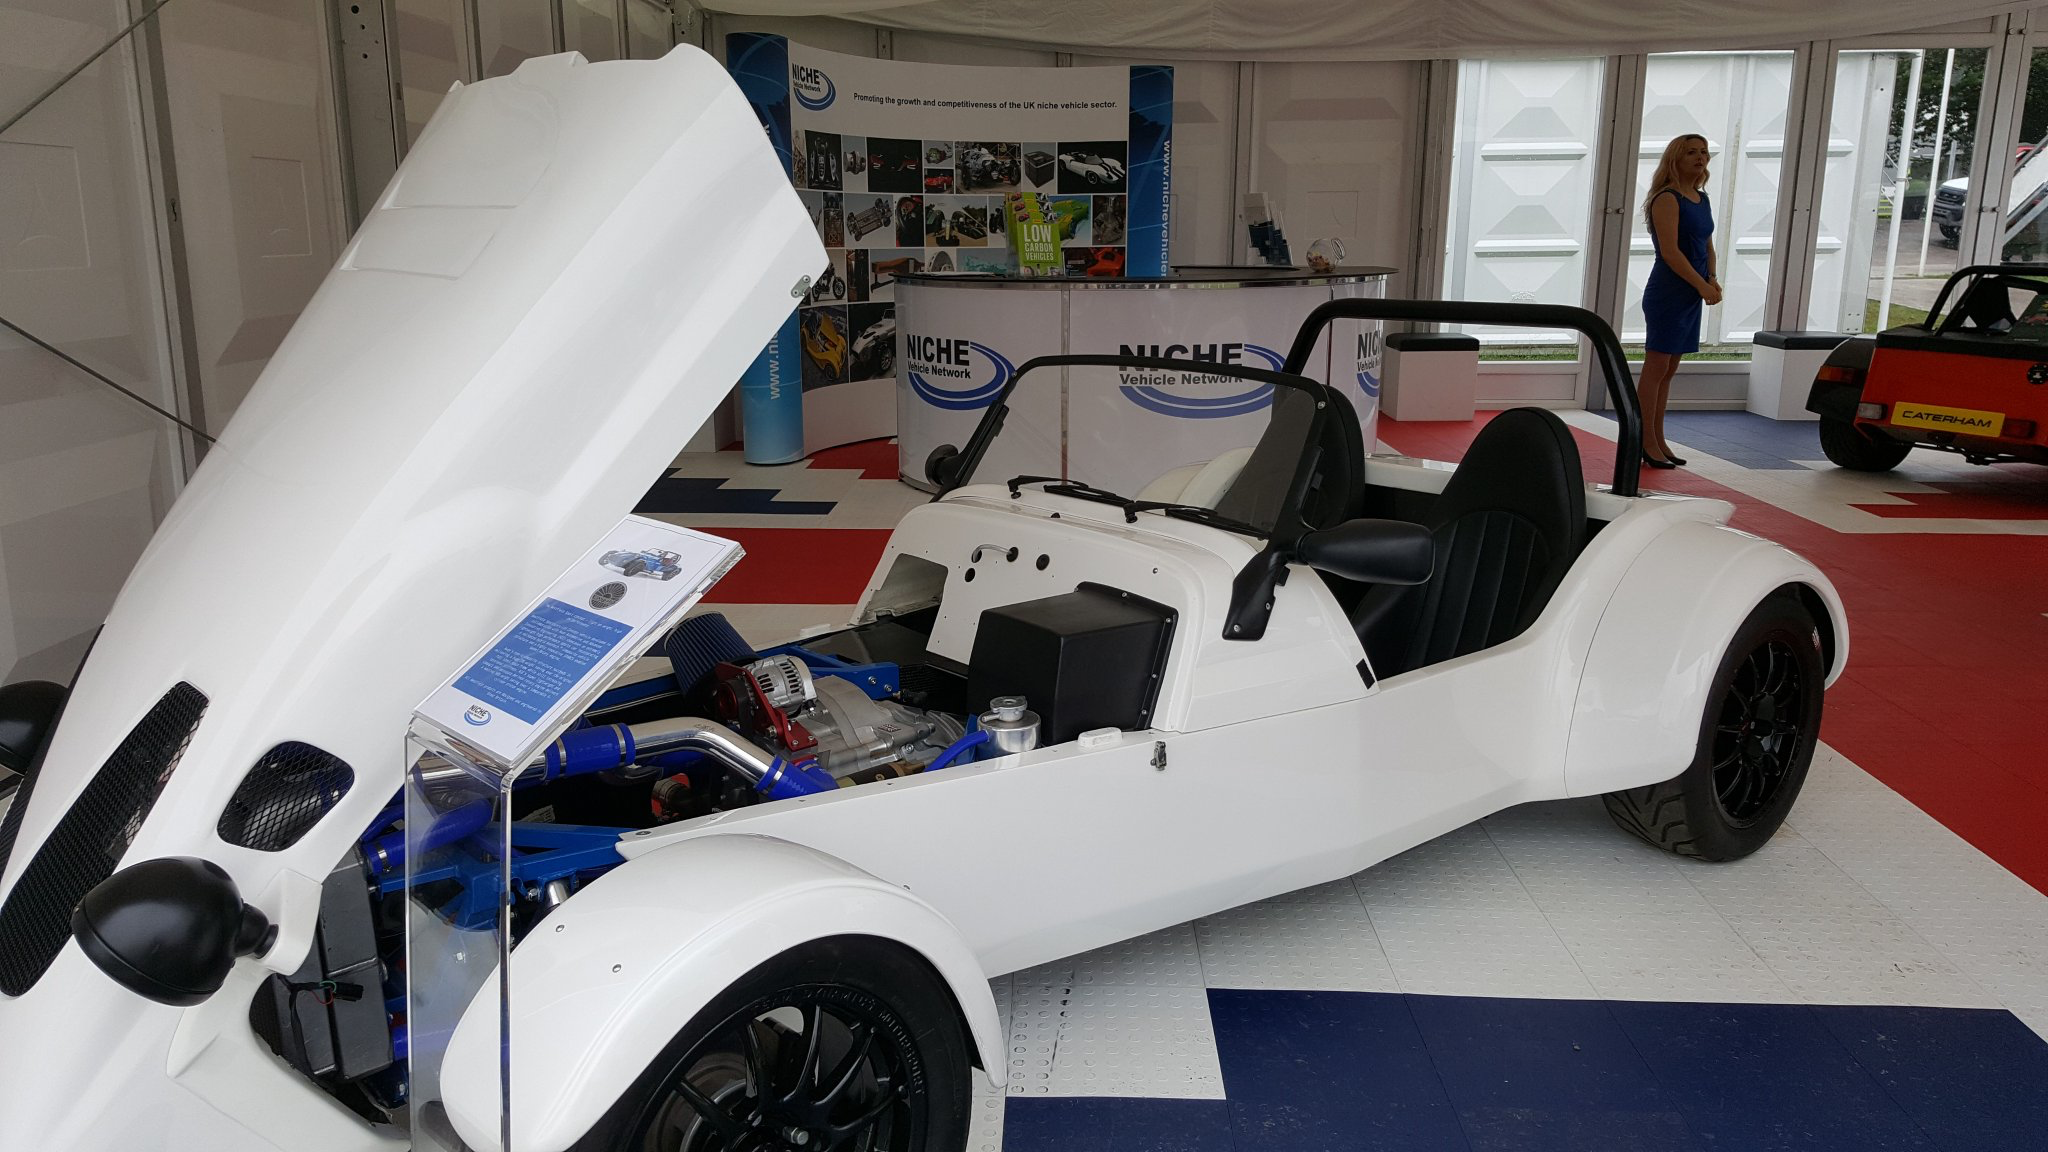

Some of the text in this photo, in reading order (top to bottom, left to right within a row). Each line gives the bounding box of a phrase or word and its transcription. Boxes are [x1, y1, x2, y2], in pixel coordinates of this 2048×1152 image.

[792, 62, 821, 86] NICHE
[853, 93, 1118, 110] Promoting the growth and competitiveness of the UK niche vehicle sector.
[1023, 224, 1051, 242] LOW
[1024, 242, 1053, 252] CARBON
[1025, 252, 1054, 261] VEHICLES
[906, 333, 970, 366] NICHE
[908, 361, 971, 379] Vehicle Network
[1119, 373, 1177, 386] Vehicle
[1902, 410, 1993, 428] CATERHAM
